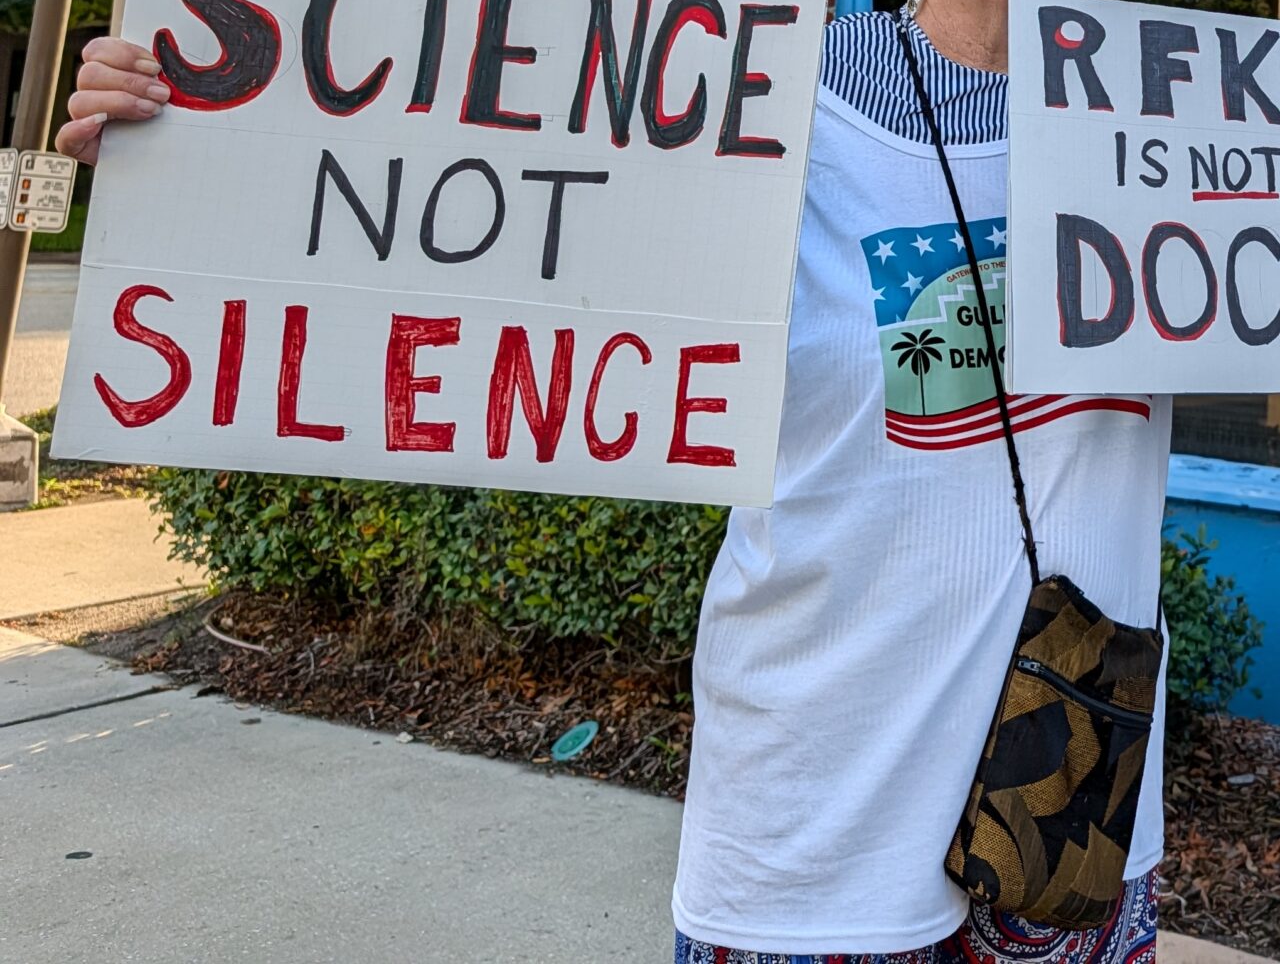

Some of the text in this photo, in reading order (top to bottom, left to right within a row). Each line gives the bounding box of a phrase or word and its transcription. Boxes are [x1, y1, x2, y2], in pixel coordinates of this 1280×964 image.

[306, 148, 610, 280] NOT
[1114, 131, 1169, 189] IS
[93, 284, 741, 467] SILENCE
